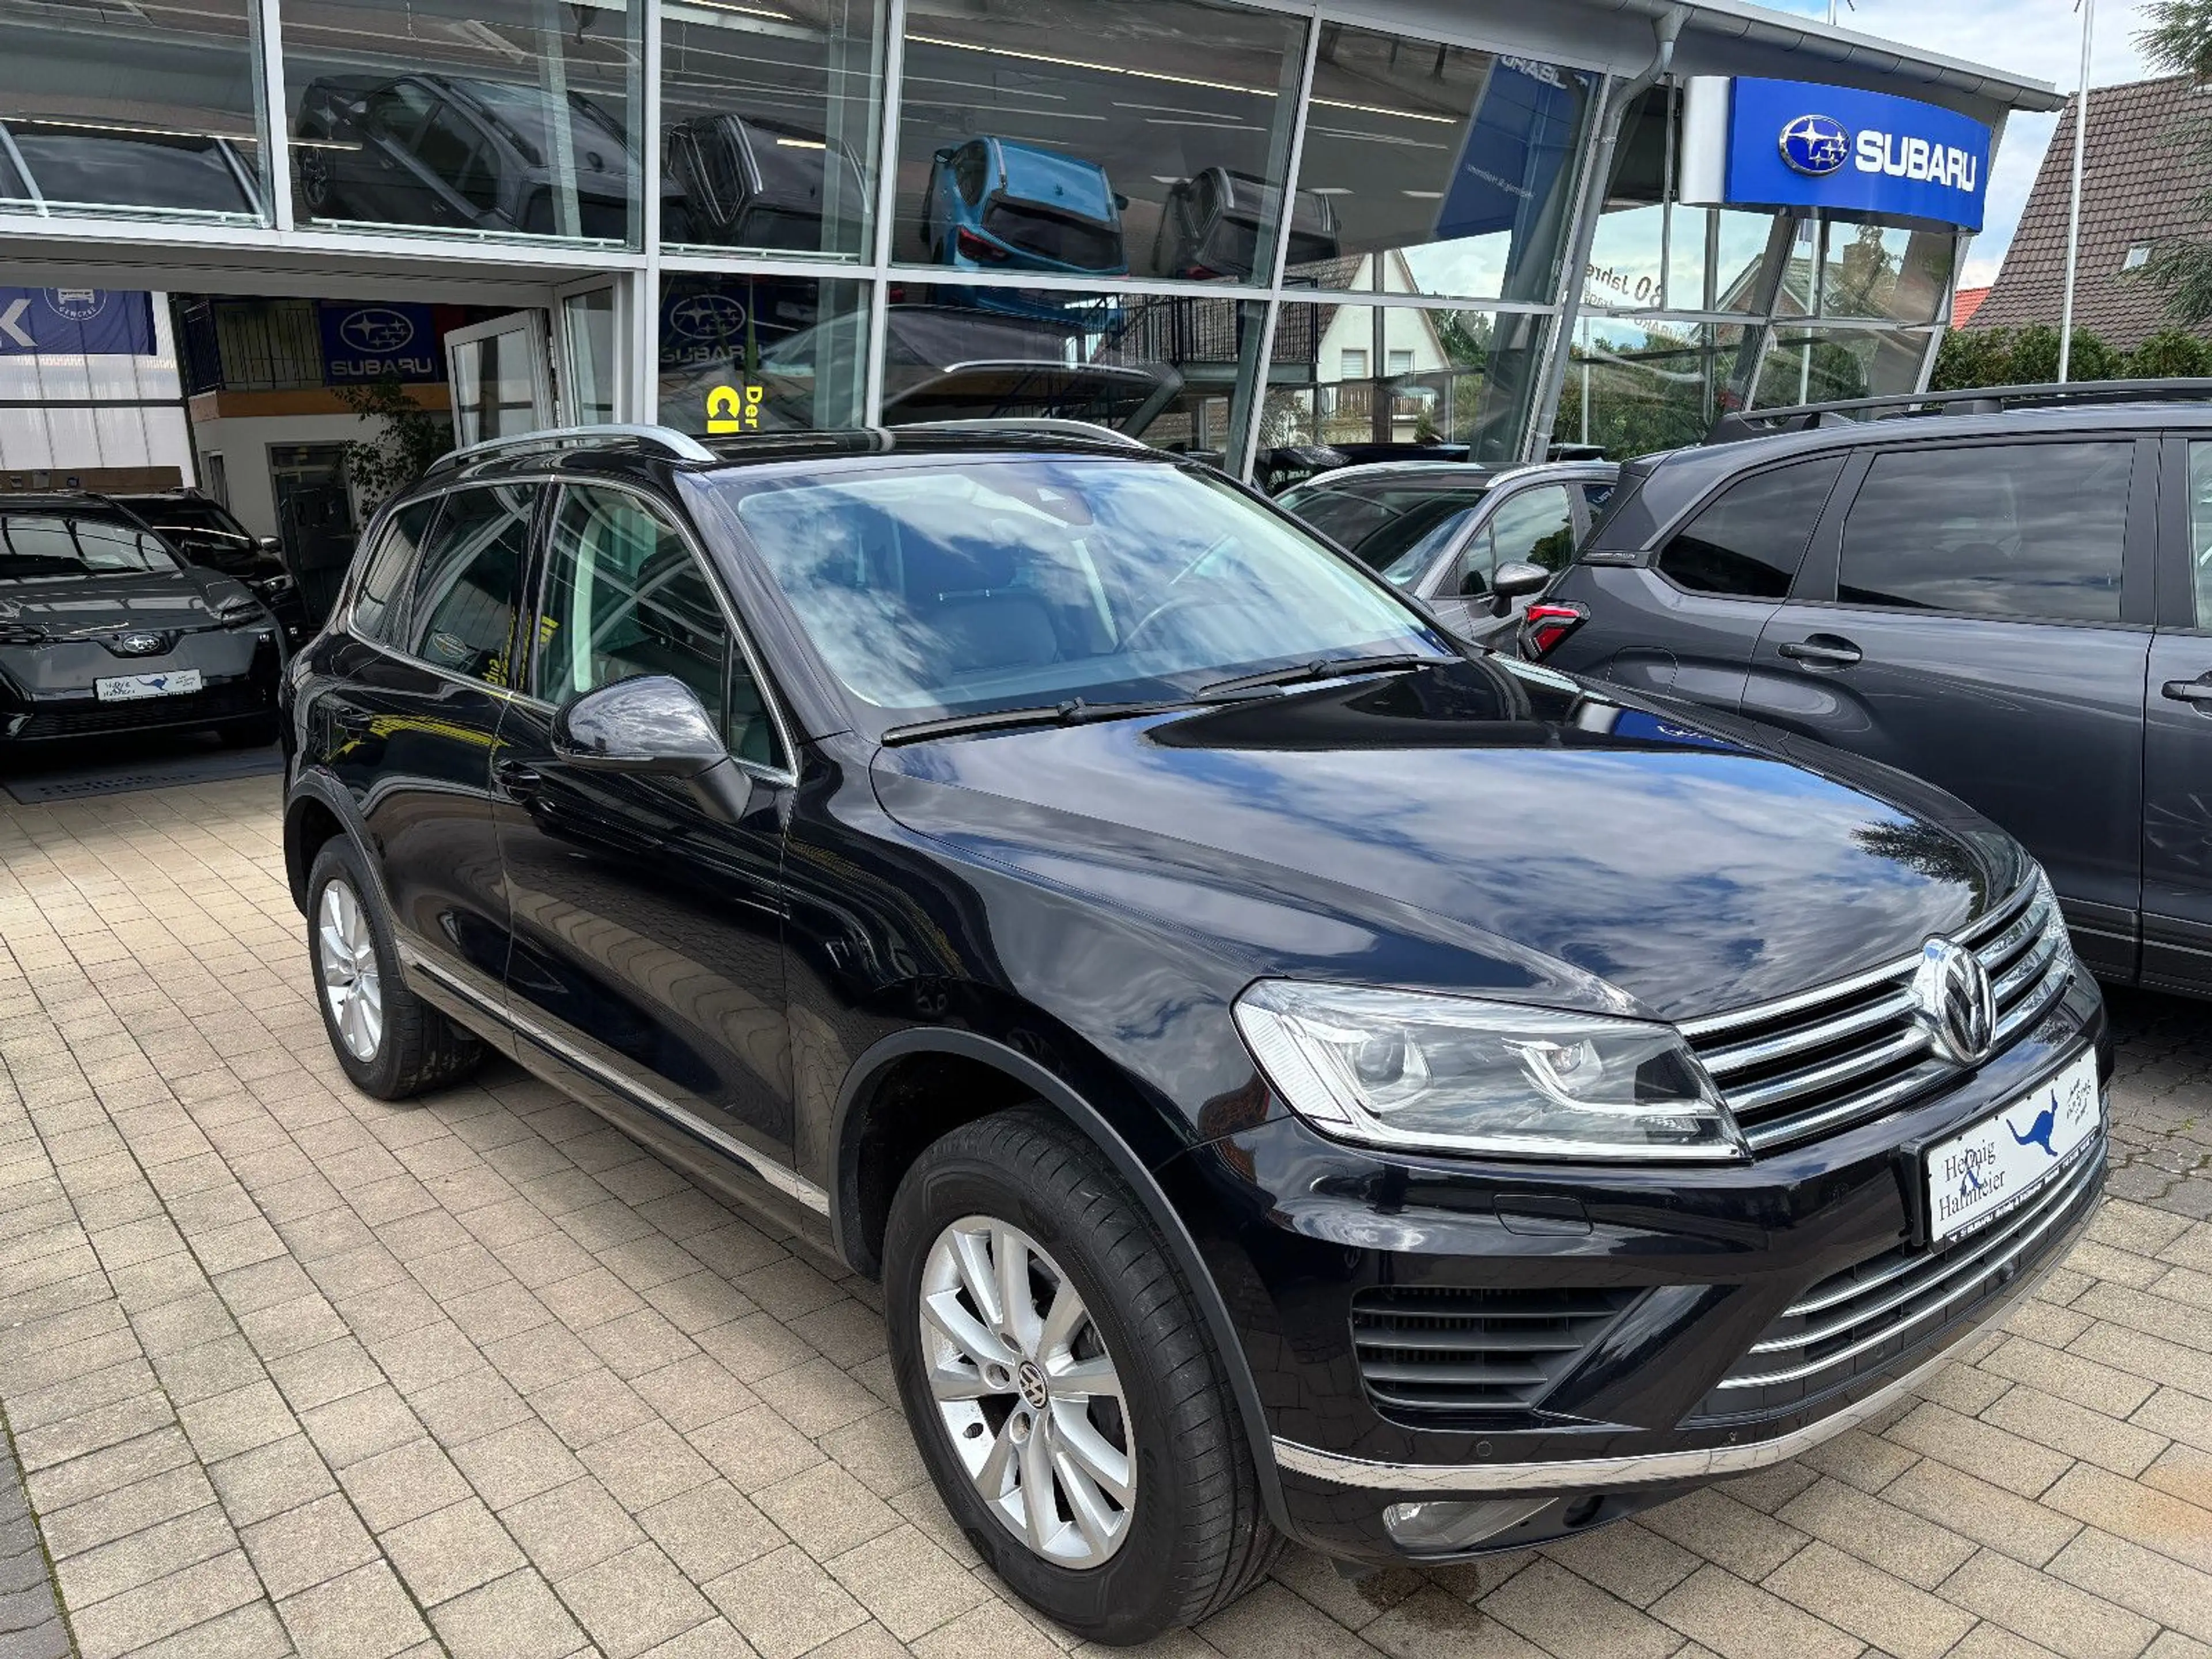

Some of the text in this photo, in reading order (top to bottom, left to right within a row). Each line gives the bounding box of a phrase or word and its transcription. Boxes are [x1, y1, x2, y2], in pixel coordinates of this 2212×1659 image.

[1855, 129, 1976, 192] SUBARU
[330, 357, 433, 376] SUBARU
[660, 344, 763, 364] SUBAR
[745, 386, 763, 429] Der
[1944, 1139, 1996, 1183] Hennig
